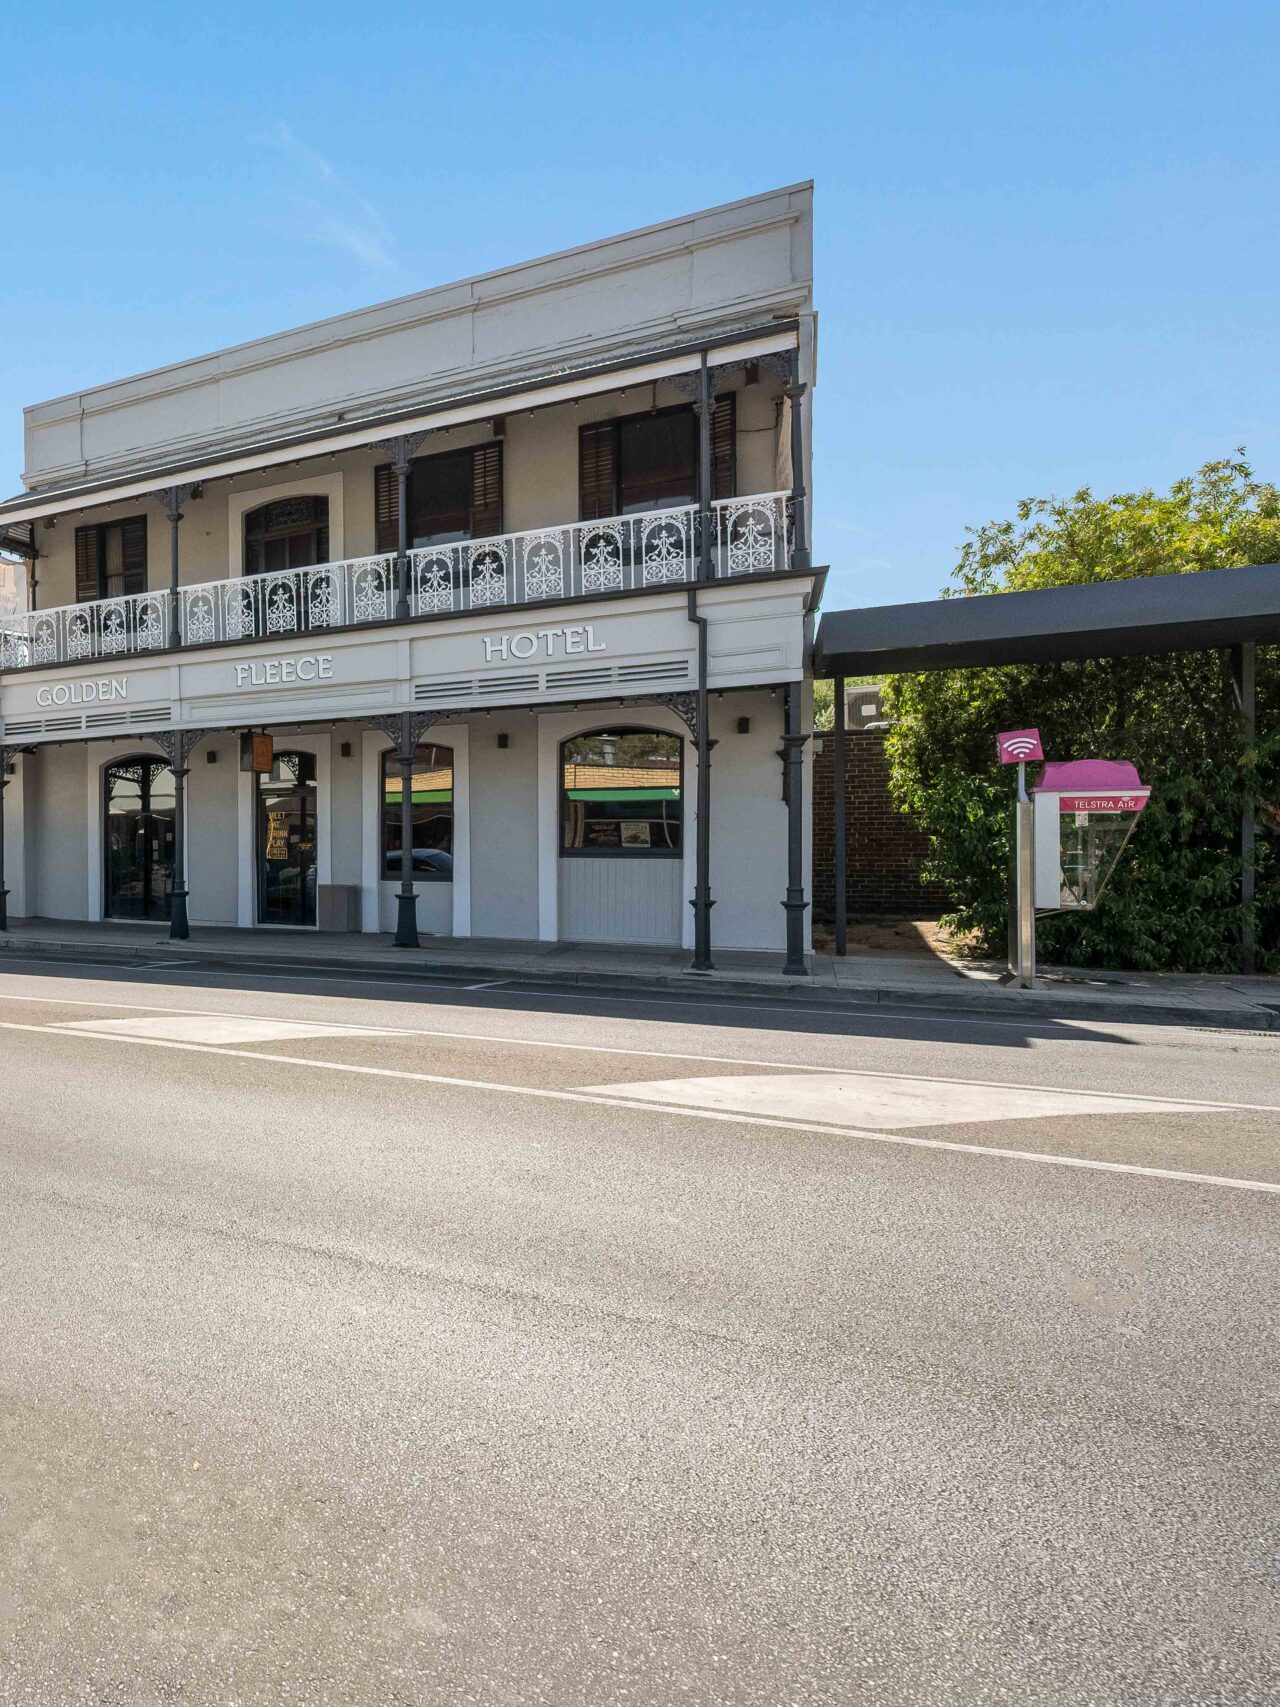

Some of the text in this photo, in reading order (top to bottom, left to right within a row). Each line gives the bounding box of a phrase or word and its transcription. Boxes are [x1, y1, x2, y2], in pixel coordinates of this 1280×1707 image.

[483, 625, 606, 662] HOTEL
[235, 655, 334, 687] FLEECE
[36, 677, 128, 707] GOLDEN
[1074, 800, 1114, 809] TELSTRA
